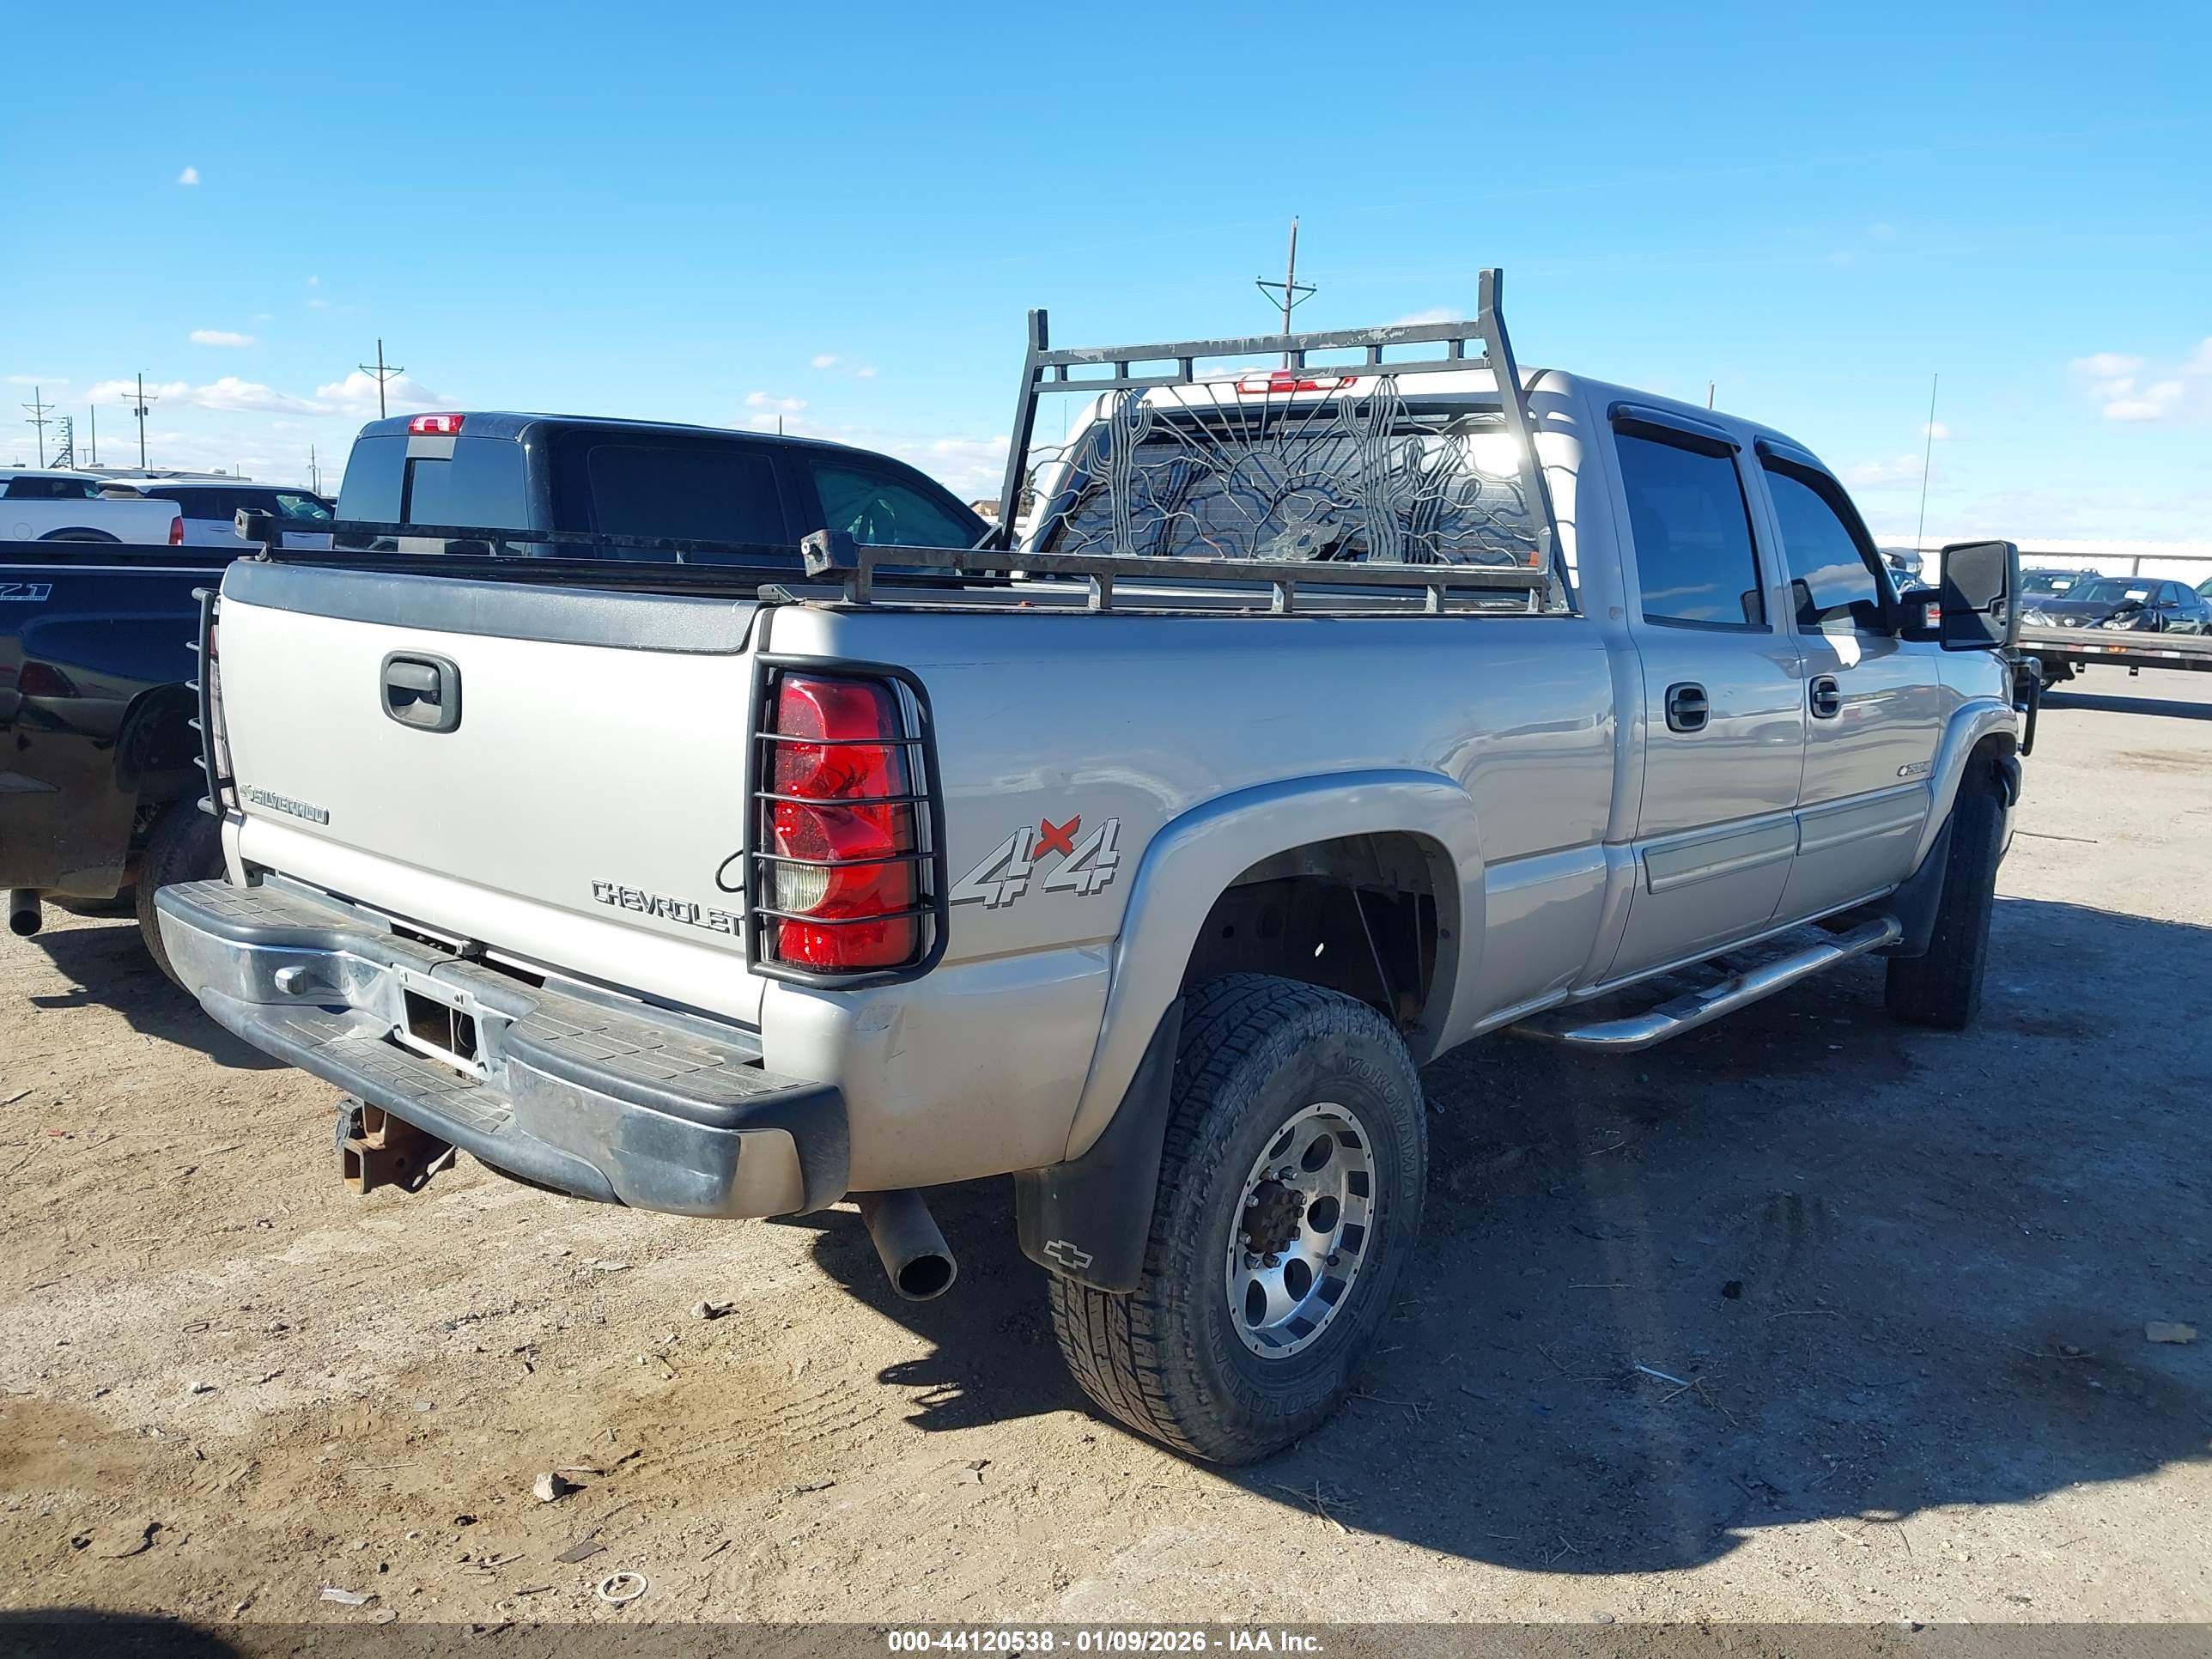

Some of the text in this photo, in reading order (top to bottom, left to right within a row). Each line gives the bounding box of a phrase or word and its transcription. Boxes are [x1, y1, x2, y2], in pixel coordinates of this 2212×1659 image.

[253, 789, 330, 826] SILVERADO
[591, 879, 745, 938] CHEVROLET
[1346, 1056, 1417, 1201] YOKOHAMA
